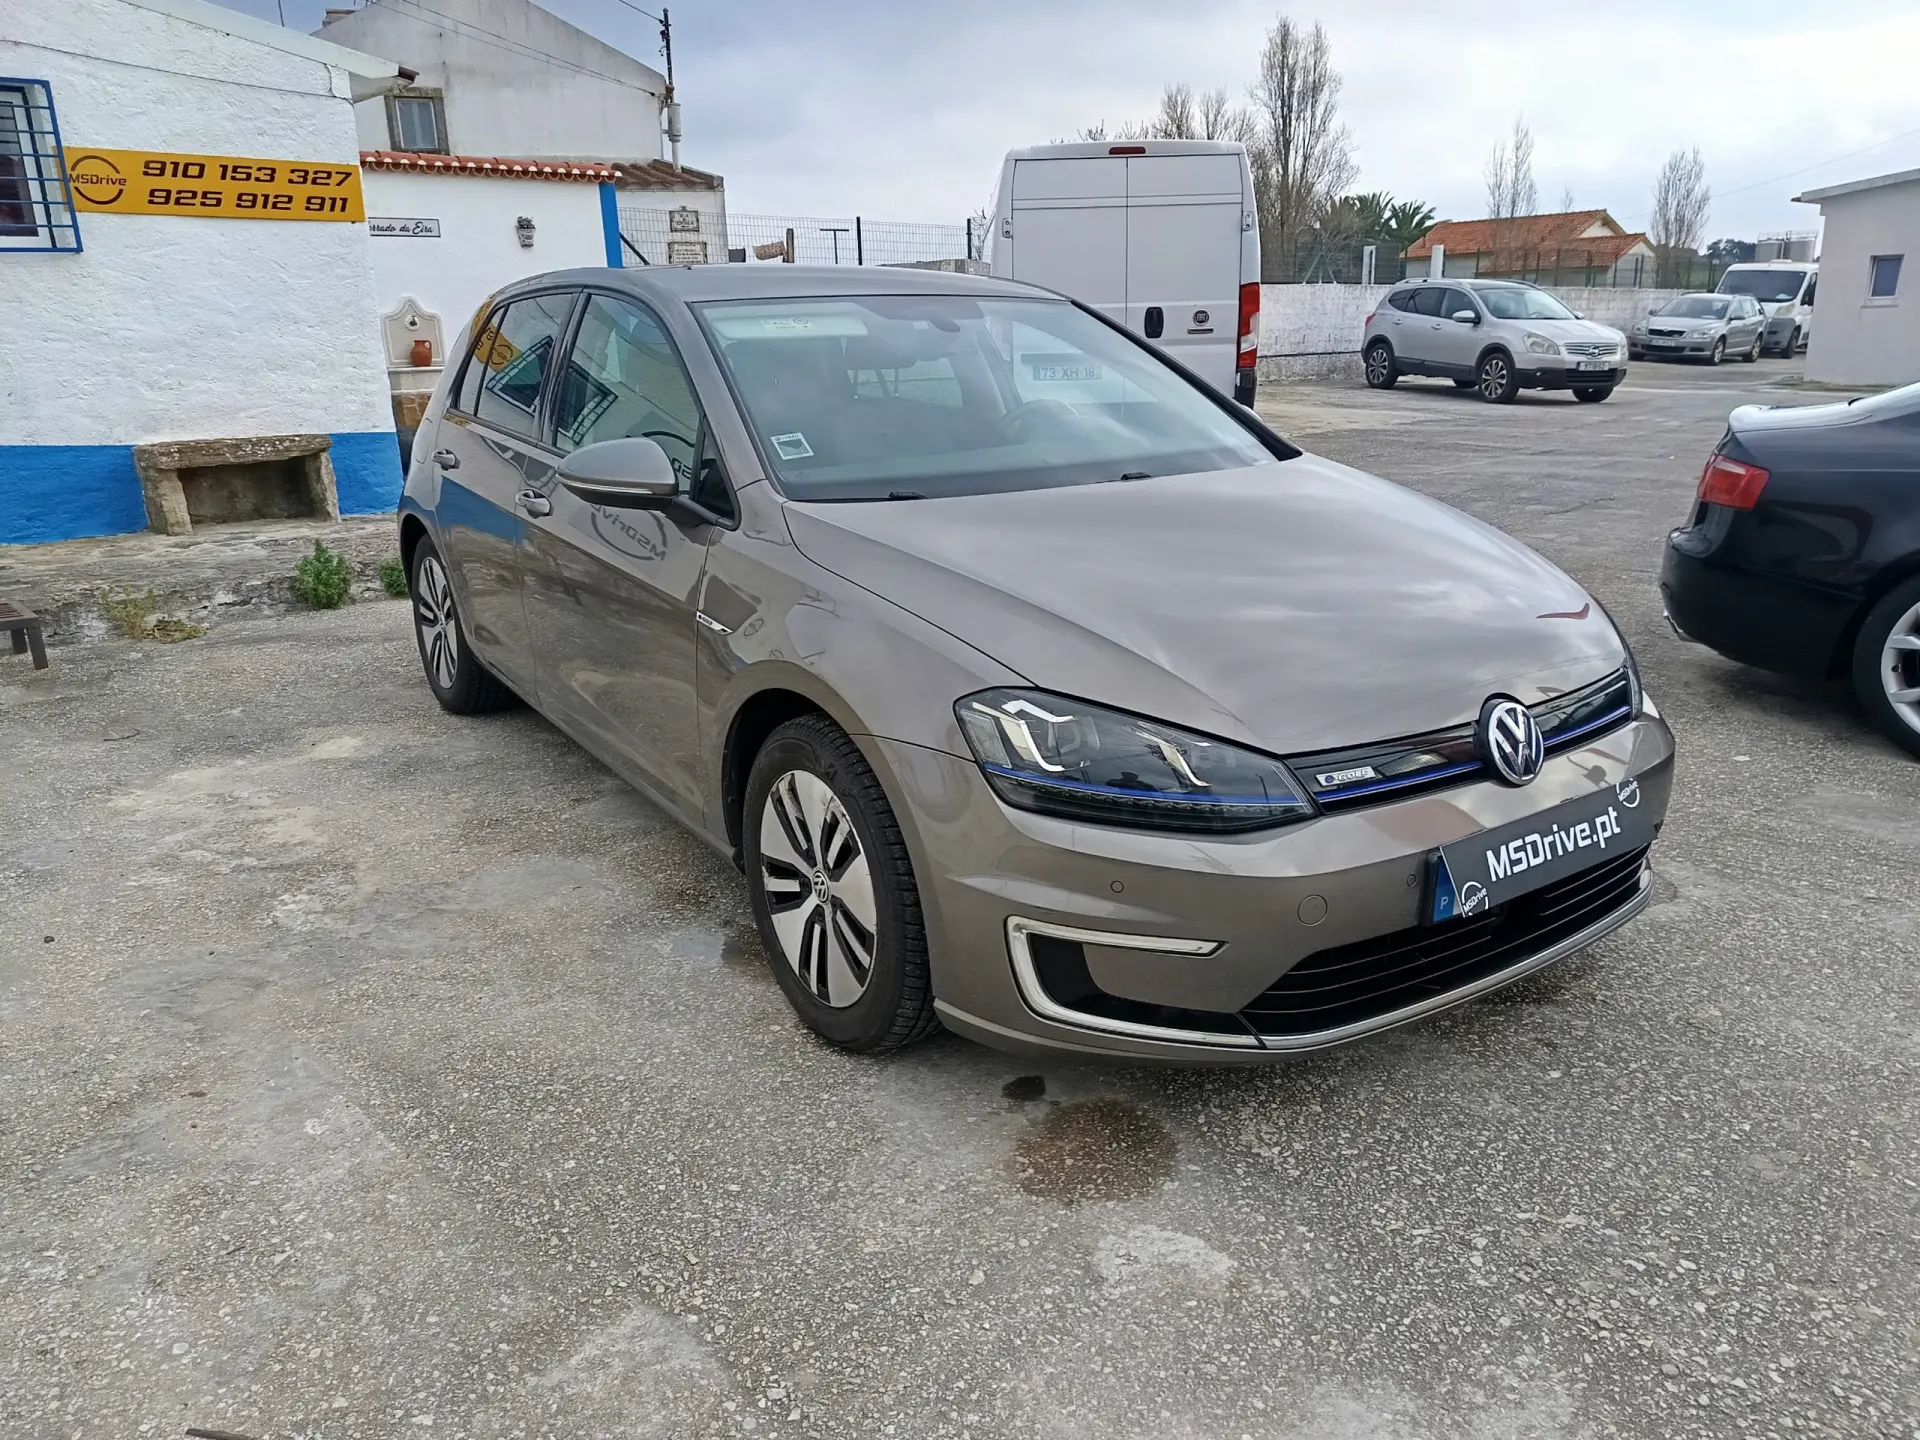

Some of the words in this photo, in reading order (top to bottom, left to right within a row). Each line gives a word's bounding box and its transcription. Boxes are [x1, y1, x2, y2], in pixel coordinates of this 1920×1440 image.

[69, 173, 127, 186] MSDrive
[142, 160, 206, 179] 910
[219, 164, 277, 183] 153
[288, 168, 352, 187] 327
[147, 188, 223, 208] 925
[235, 192, 293, 211] 912
[305, 195, 348, 213] 911
[369, 222, 396, 233] errado
[399, 224, 411, 233] da
[412, 221, 434, 235] Eira
[1618, 779, 1639, 802] MSDrive
[1486, 806, 1621, 882] MSDrive.pt
[1439, 895, 1449, 910] P
[1462, 887, 1487, 913] MSDrive
